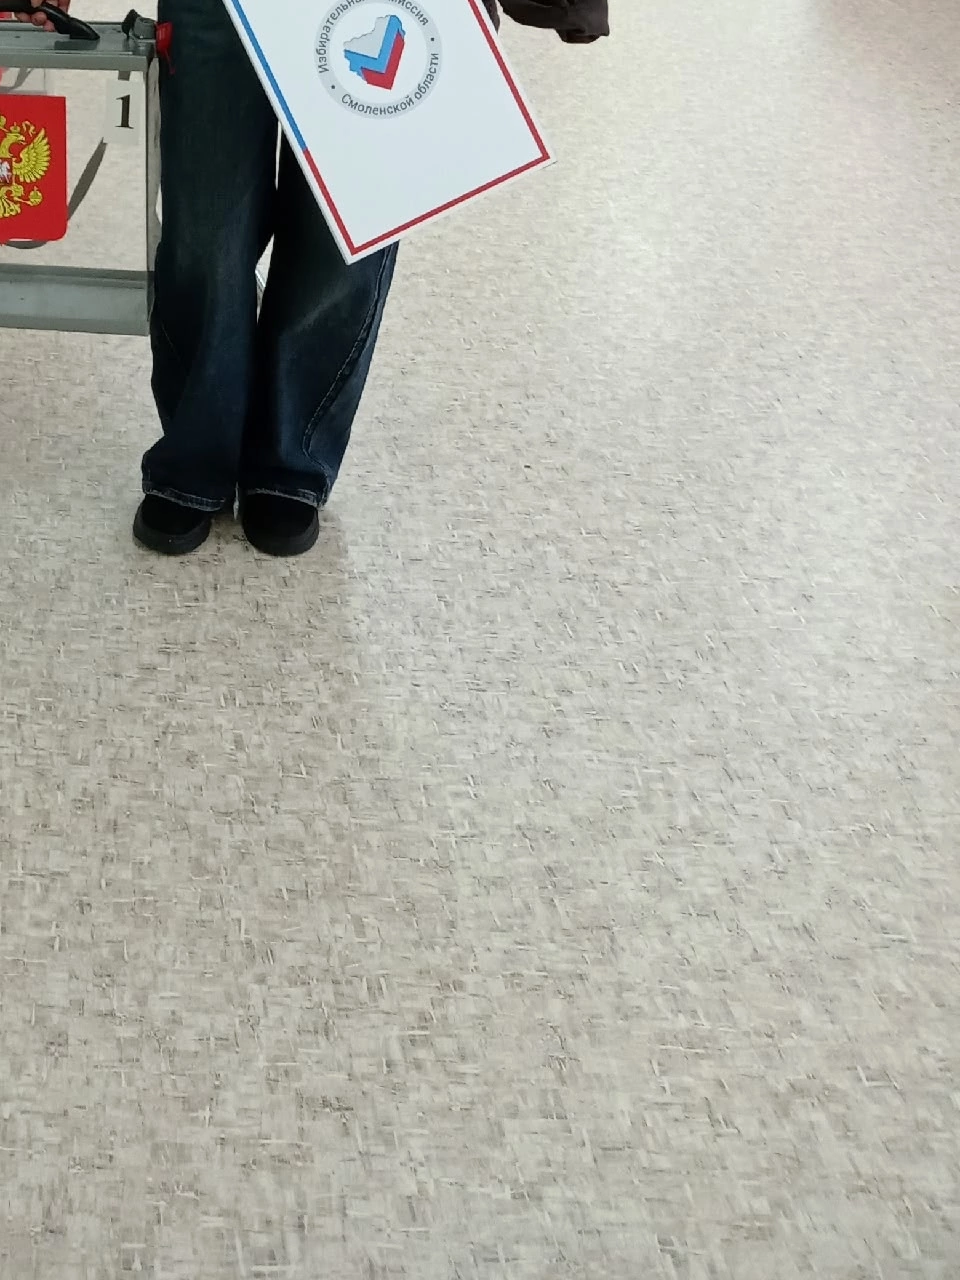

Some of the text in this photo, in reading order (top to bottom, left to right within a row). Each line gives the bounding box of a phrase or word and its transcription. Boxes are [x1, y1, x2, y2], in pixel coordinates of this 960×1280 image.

[341, 53, 439, 116] Смоленской области
[114, 94, 135, 129] 1
